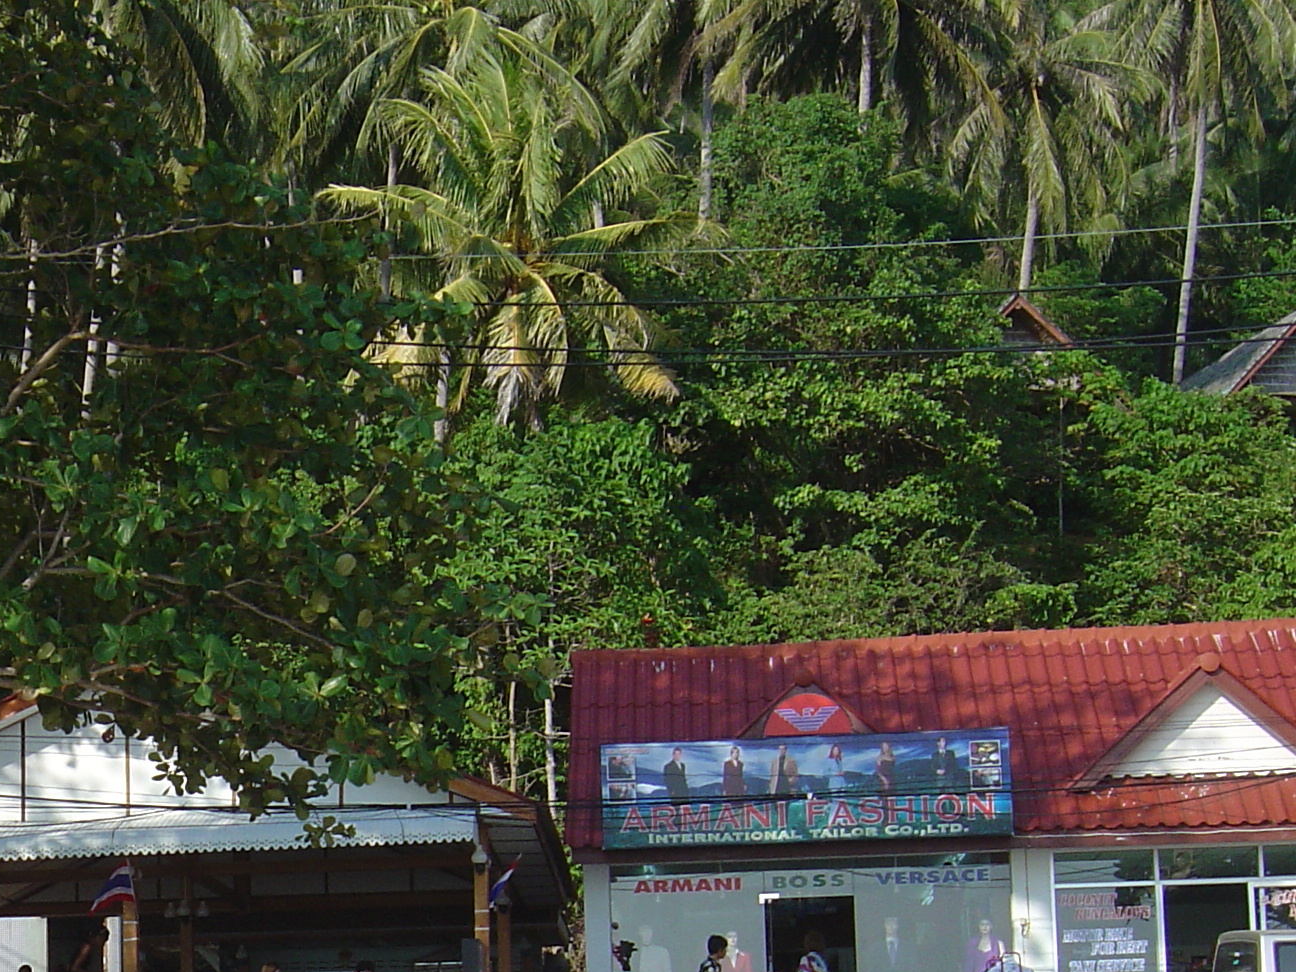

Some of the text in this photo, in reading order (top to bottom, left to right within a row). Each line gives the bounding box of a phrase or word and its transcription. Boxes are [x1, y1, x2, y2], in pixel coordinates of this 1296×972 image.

[620, 793, 996, 833] ARMANI FASHION
[648, 830, 803, 844] INTERNATIONAL
[809, 826, 878, 838] TAILOR
[771, 874, 845, 889] BOSS
[875, 868, 990, 885] VERSACE
[633, 877, 743, 893] ARMANI
[1059, 892, 1117, 906] COCONUT
[1075, 906, 1151, 920] BUNGALOWS
[1091, 940, 1148, 956] FOR RENT
[1096, 958, 1145, 972] SERVICE
